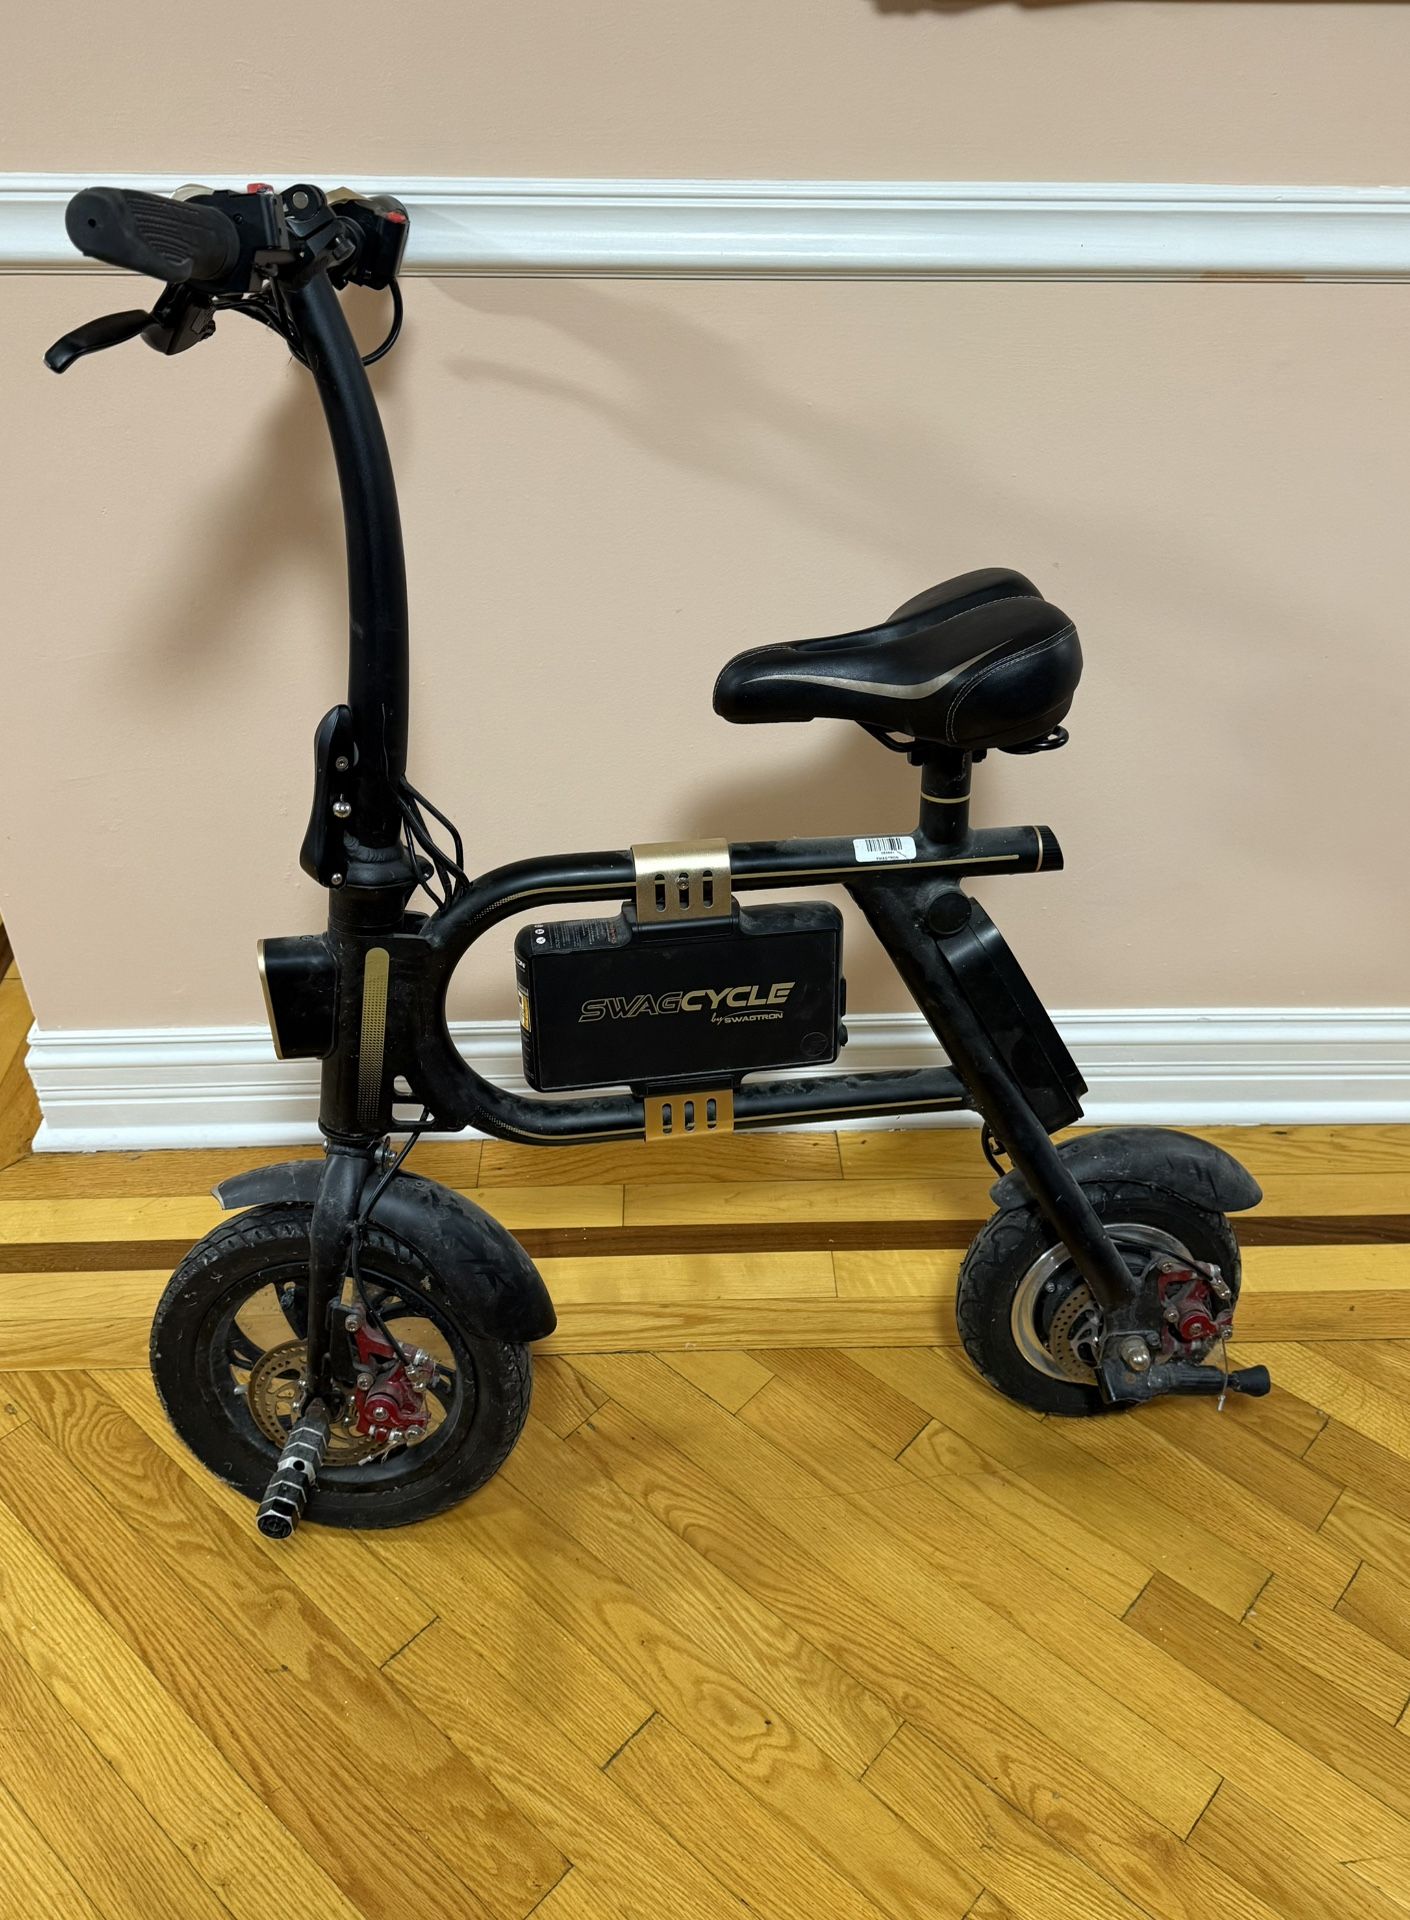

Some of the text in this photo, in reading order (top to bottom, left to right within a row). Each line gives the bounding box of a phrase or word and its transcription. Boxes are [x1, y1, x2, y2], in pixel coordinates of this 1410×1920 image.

[578, 982, 795, 1022] SWAGCYCLE
[711, 1012, 783, 1025] by SWAGTRON
